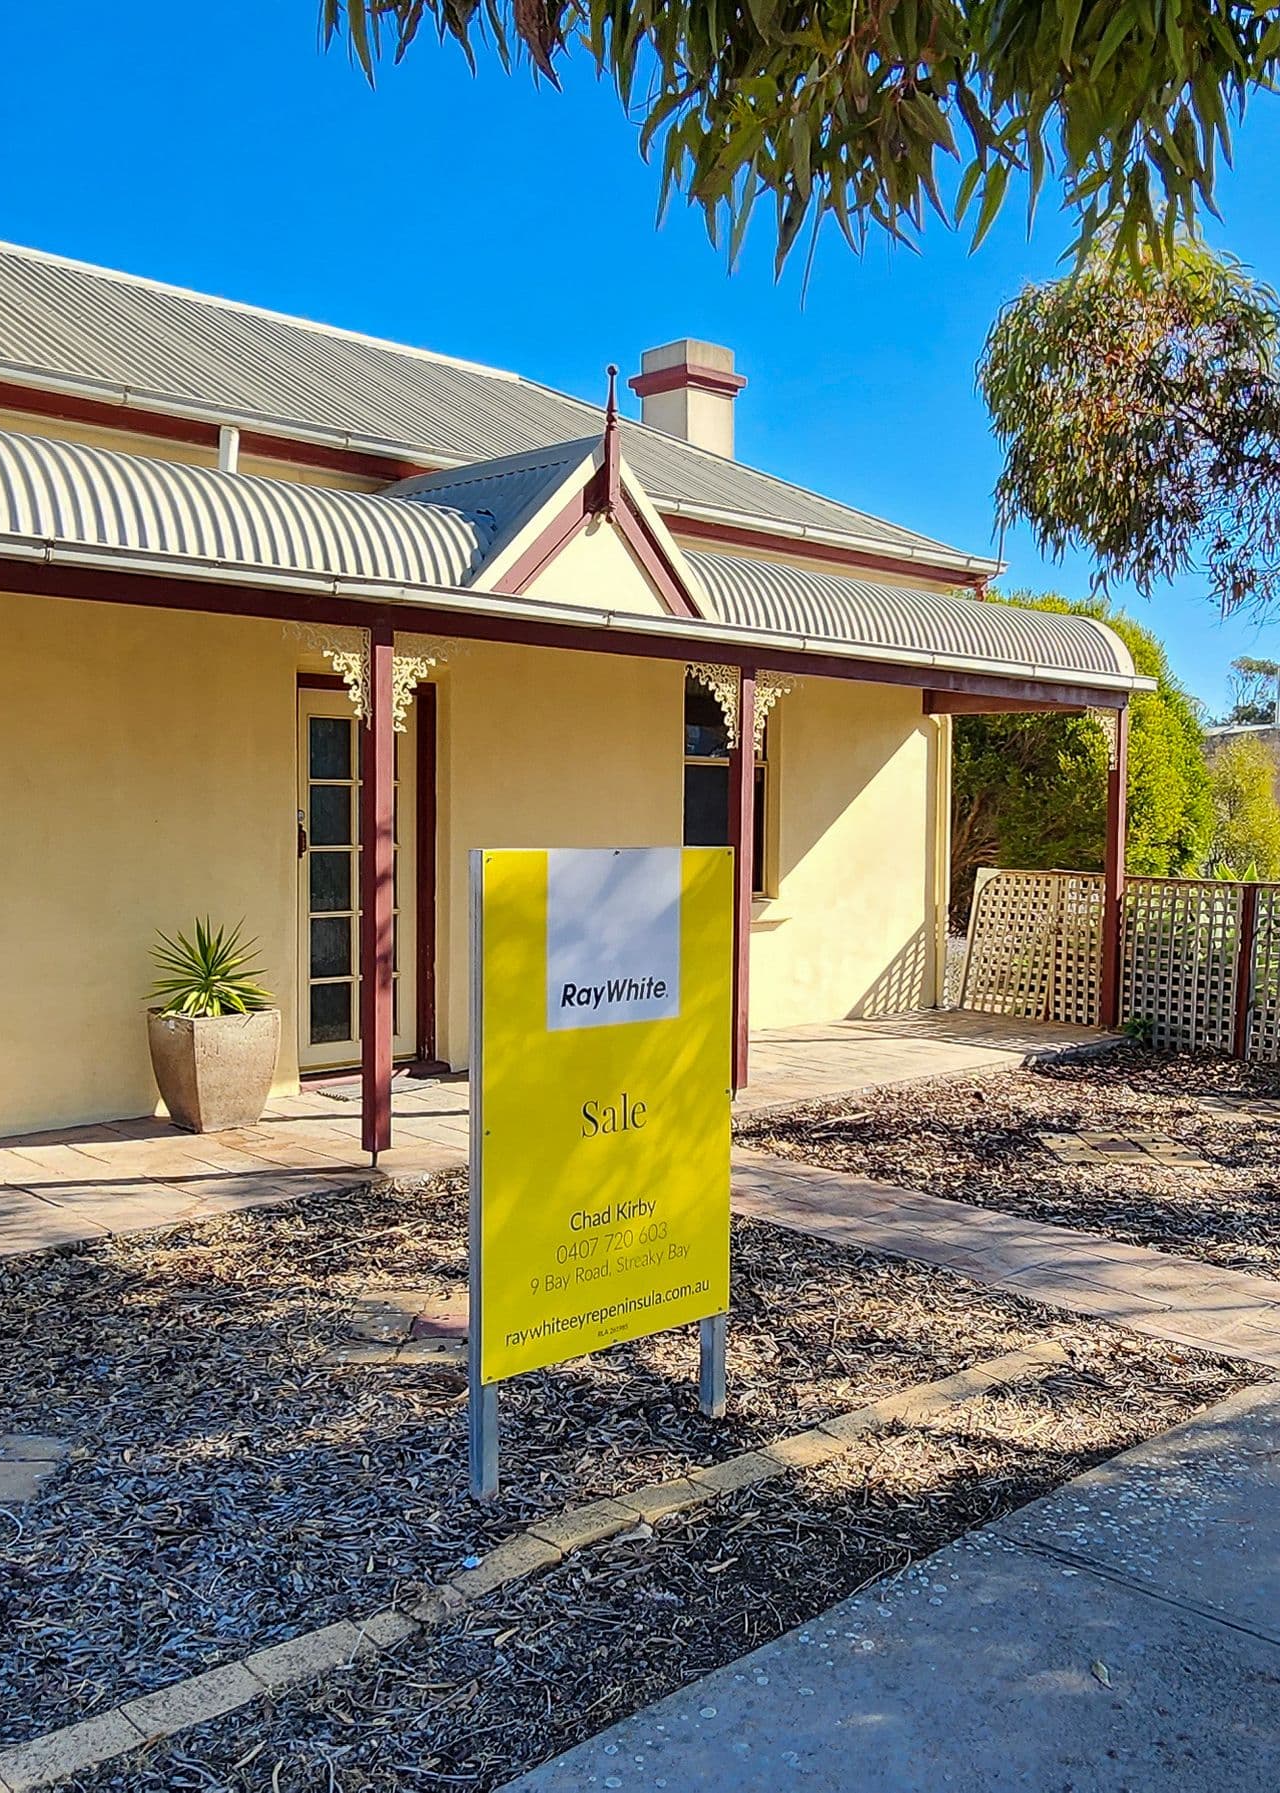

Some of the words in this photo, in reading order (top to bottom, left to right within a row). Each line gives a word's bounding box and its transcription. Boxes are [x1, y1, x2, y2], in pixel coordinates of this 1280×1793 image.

[581, 1092, 647, 1138] Sale
[570, 1206, 611, 1232] Chad
[616, 1198, 656, 1221] Kirby
[556, 1236, 598, 1265] 0407
[604, 1229, 634, 1253] 720
[639, 1221, 668, 1246] 603
[530, 1277, 540, 1296] 9
[545, 1273, 570, 1293] Bay
[616, 1249, 664, 1273] Streaky
[668, 1243, 690, 1260] Bay
[505, 1279, 710, 1348] raywhiteeyrepeninsula.com.au
